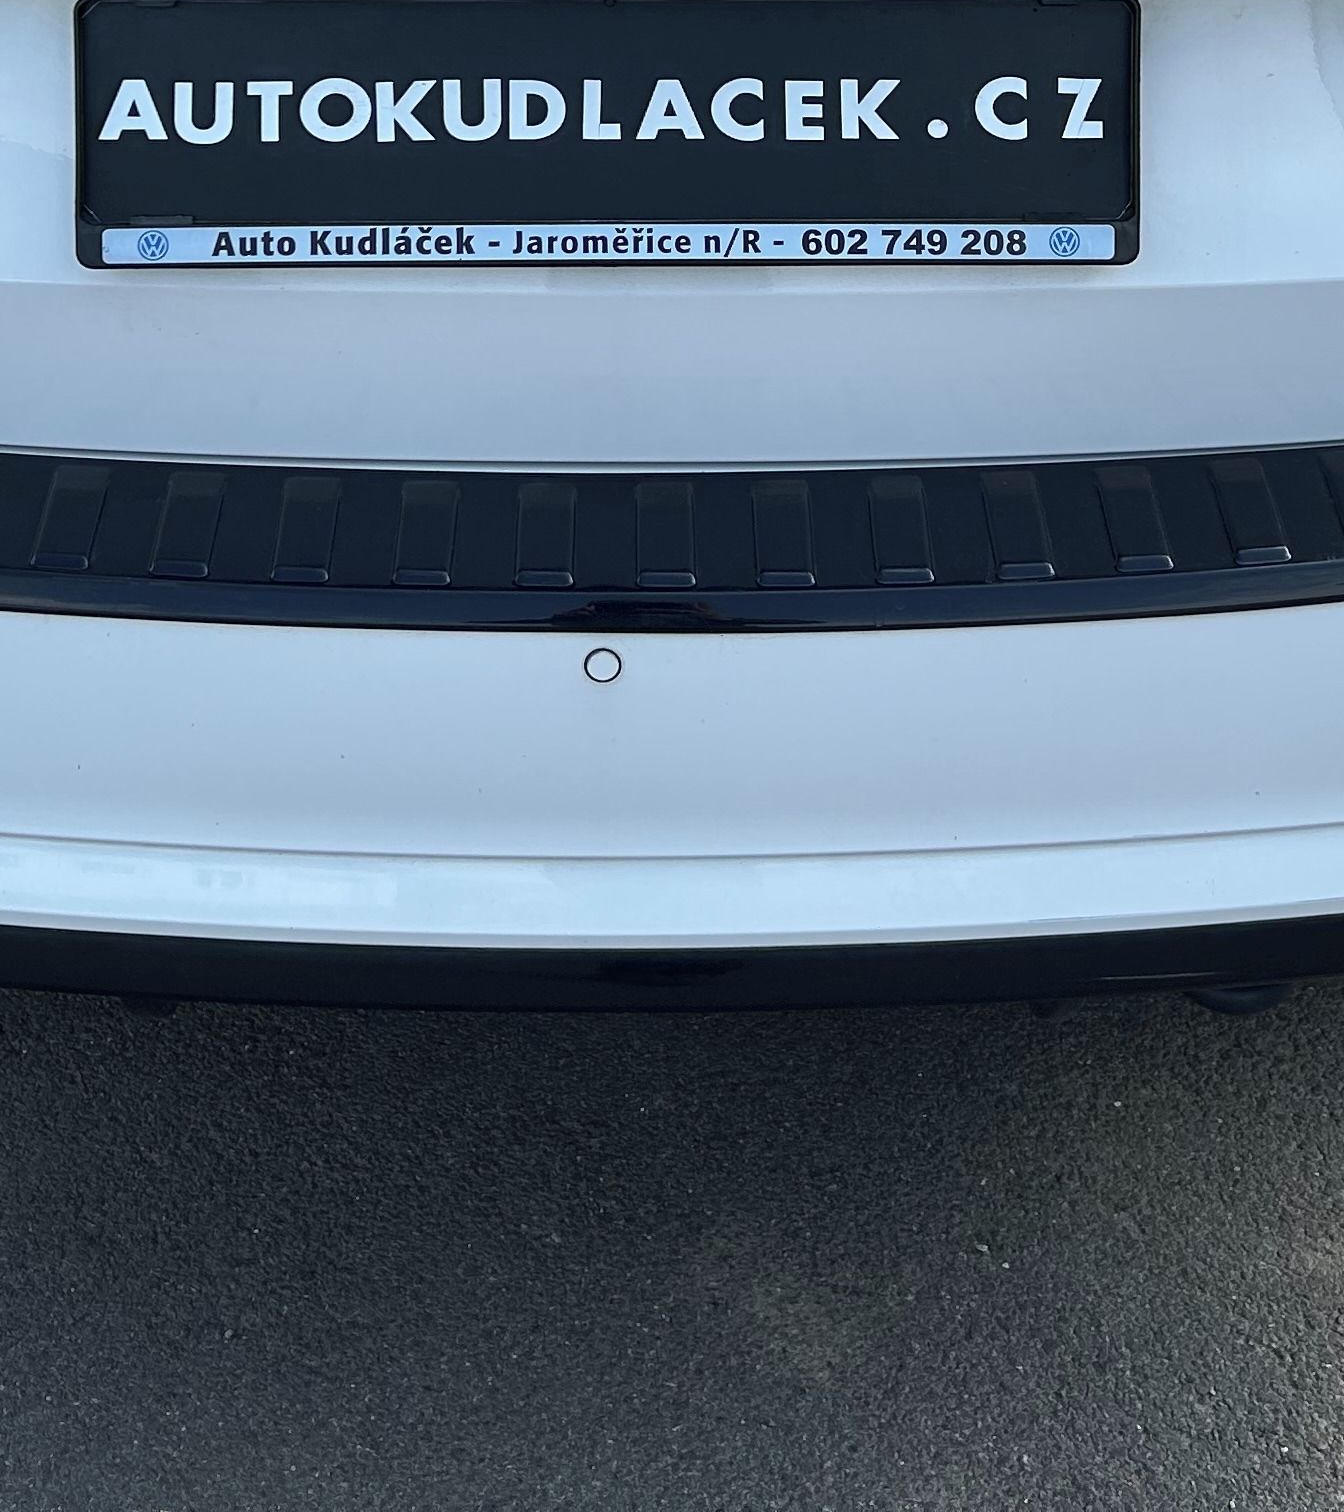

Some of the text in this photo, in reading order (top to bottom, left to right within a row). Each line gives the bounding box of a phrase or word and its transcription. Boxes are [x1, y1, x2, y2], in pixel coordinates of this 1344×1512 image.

[212, 230, 296, 257] Auto
[310, 227, 475, 256] Kudláček
[512, 226, 692, 256] Jaroměřice
[703, 227, 761, 258] n/R
[801, 228, 868, 256] 602
[881, 228, 948, 256] 749
[960, 228, 1027, 256] 208
